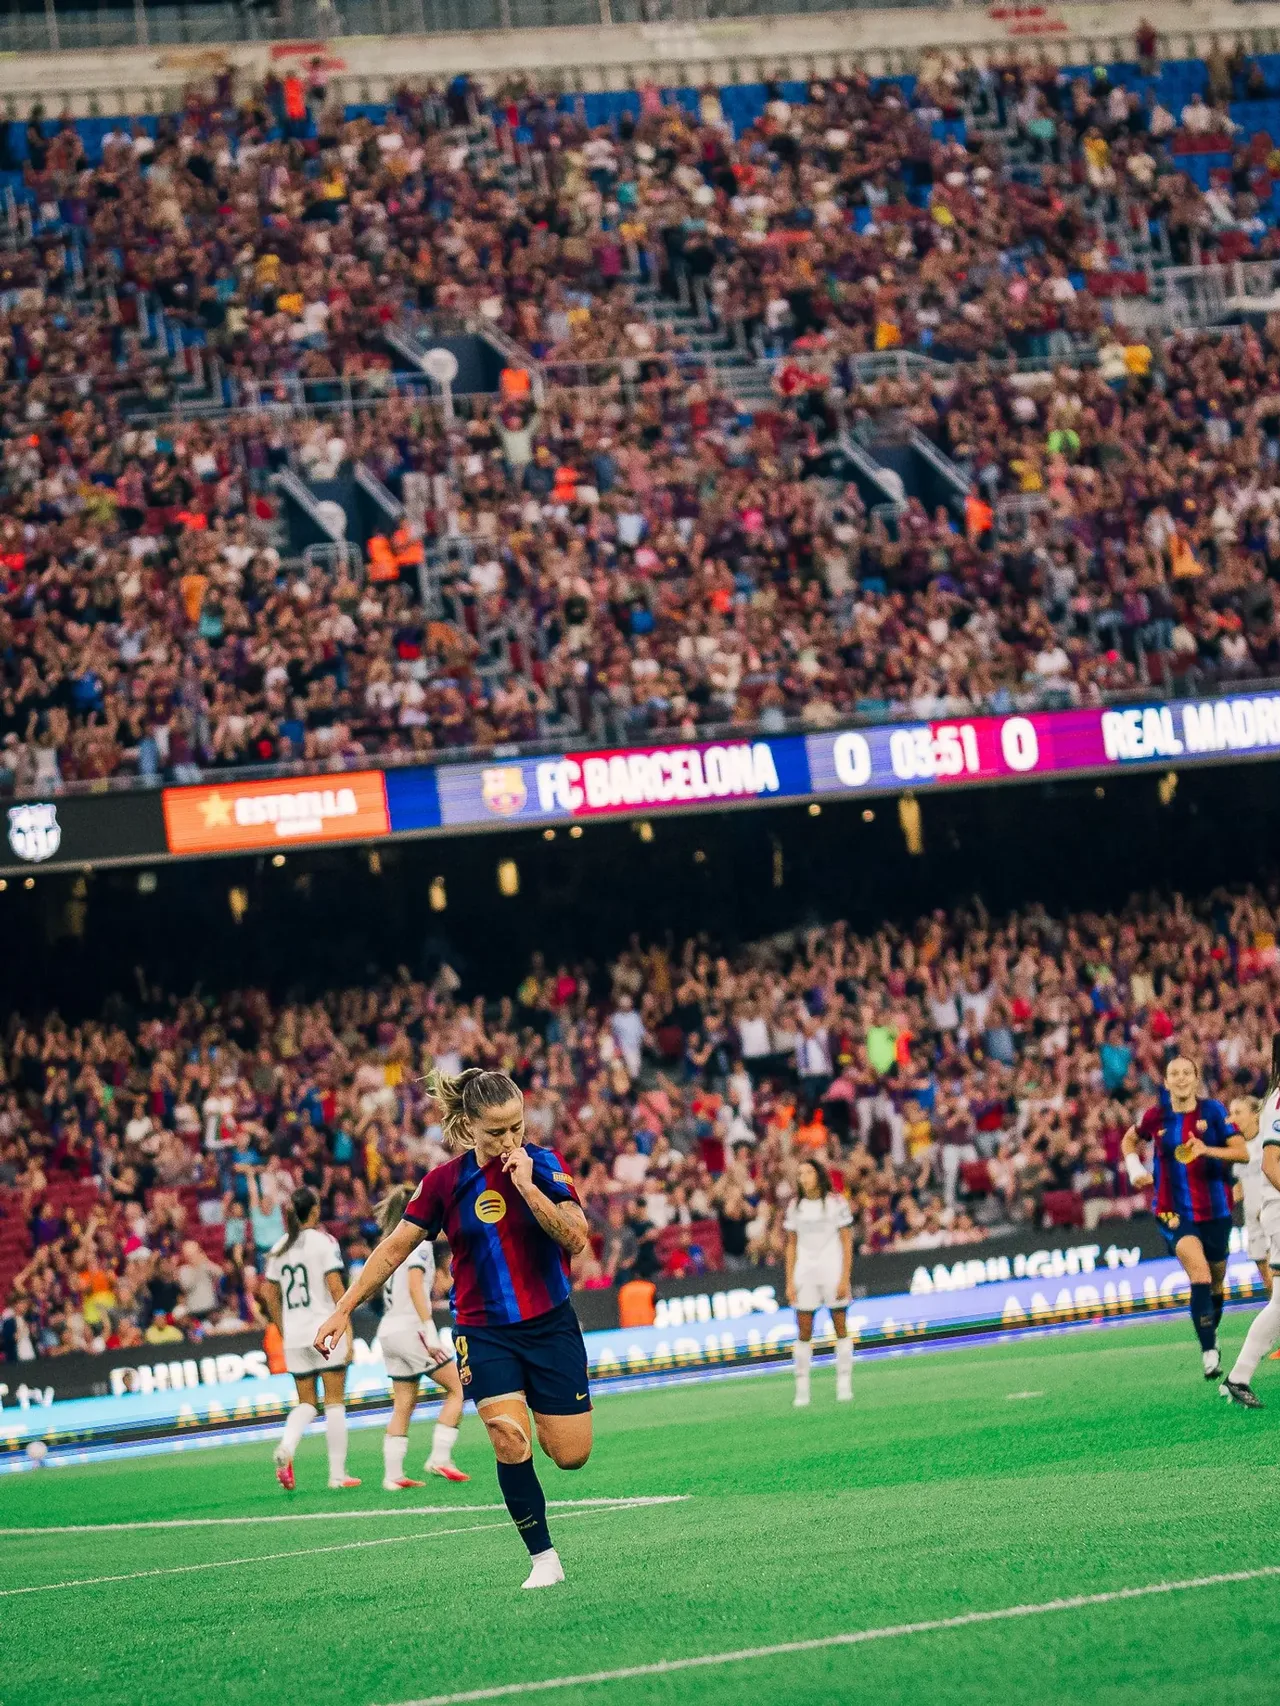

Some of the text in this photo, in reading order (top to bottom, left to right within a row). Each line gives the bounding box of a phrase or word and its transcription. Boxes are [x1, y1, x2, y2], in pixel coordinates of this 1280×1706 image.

[833, 731, 871, 786] 0
[1001, 716, 1039, 771] 0
[1101, 704, 1184, 761] REAL
[536, 741, 779, 812] FC BARCELONA
[281, 1263, 311, 1310] 23
[911, 1243, 1142, 1297] AMBILIGHT tv
[652, 1285, 781, 1329] HILIPS
[109, 1351, 272, 1397] PHILIPS
